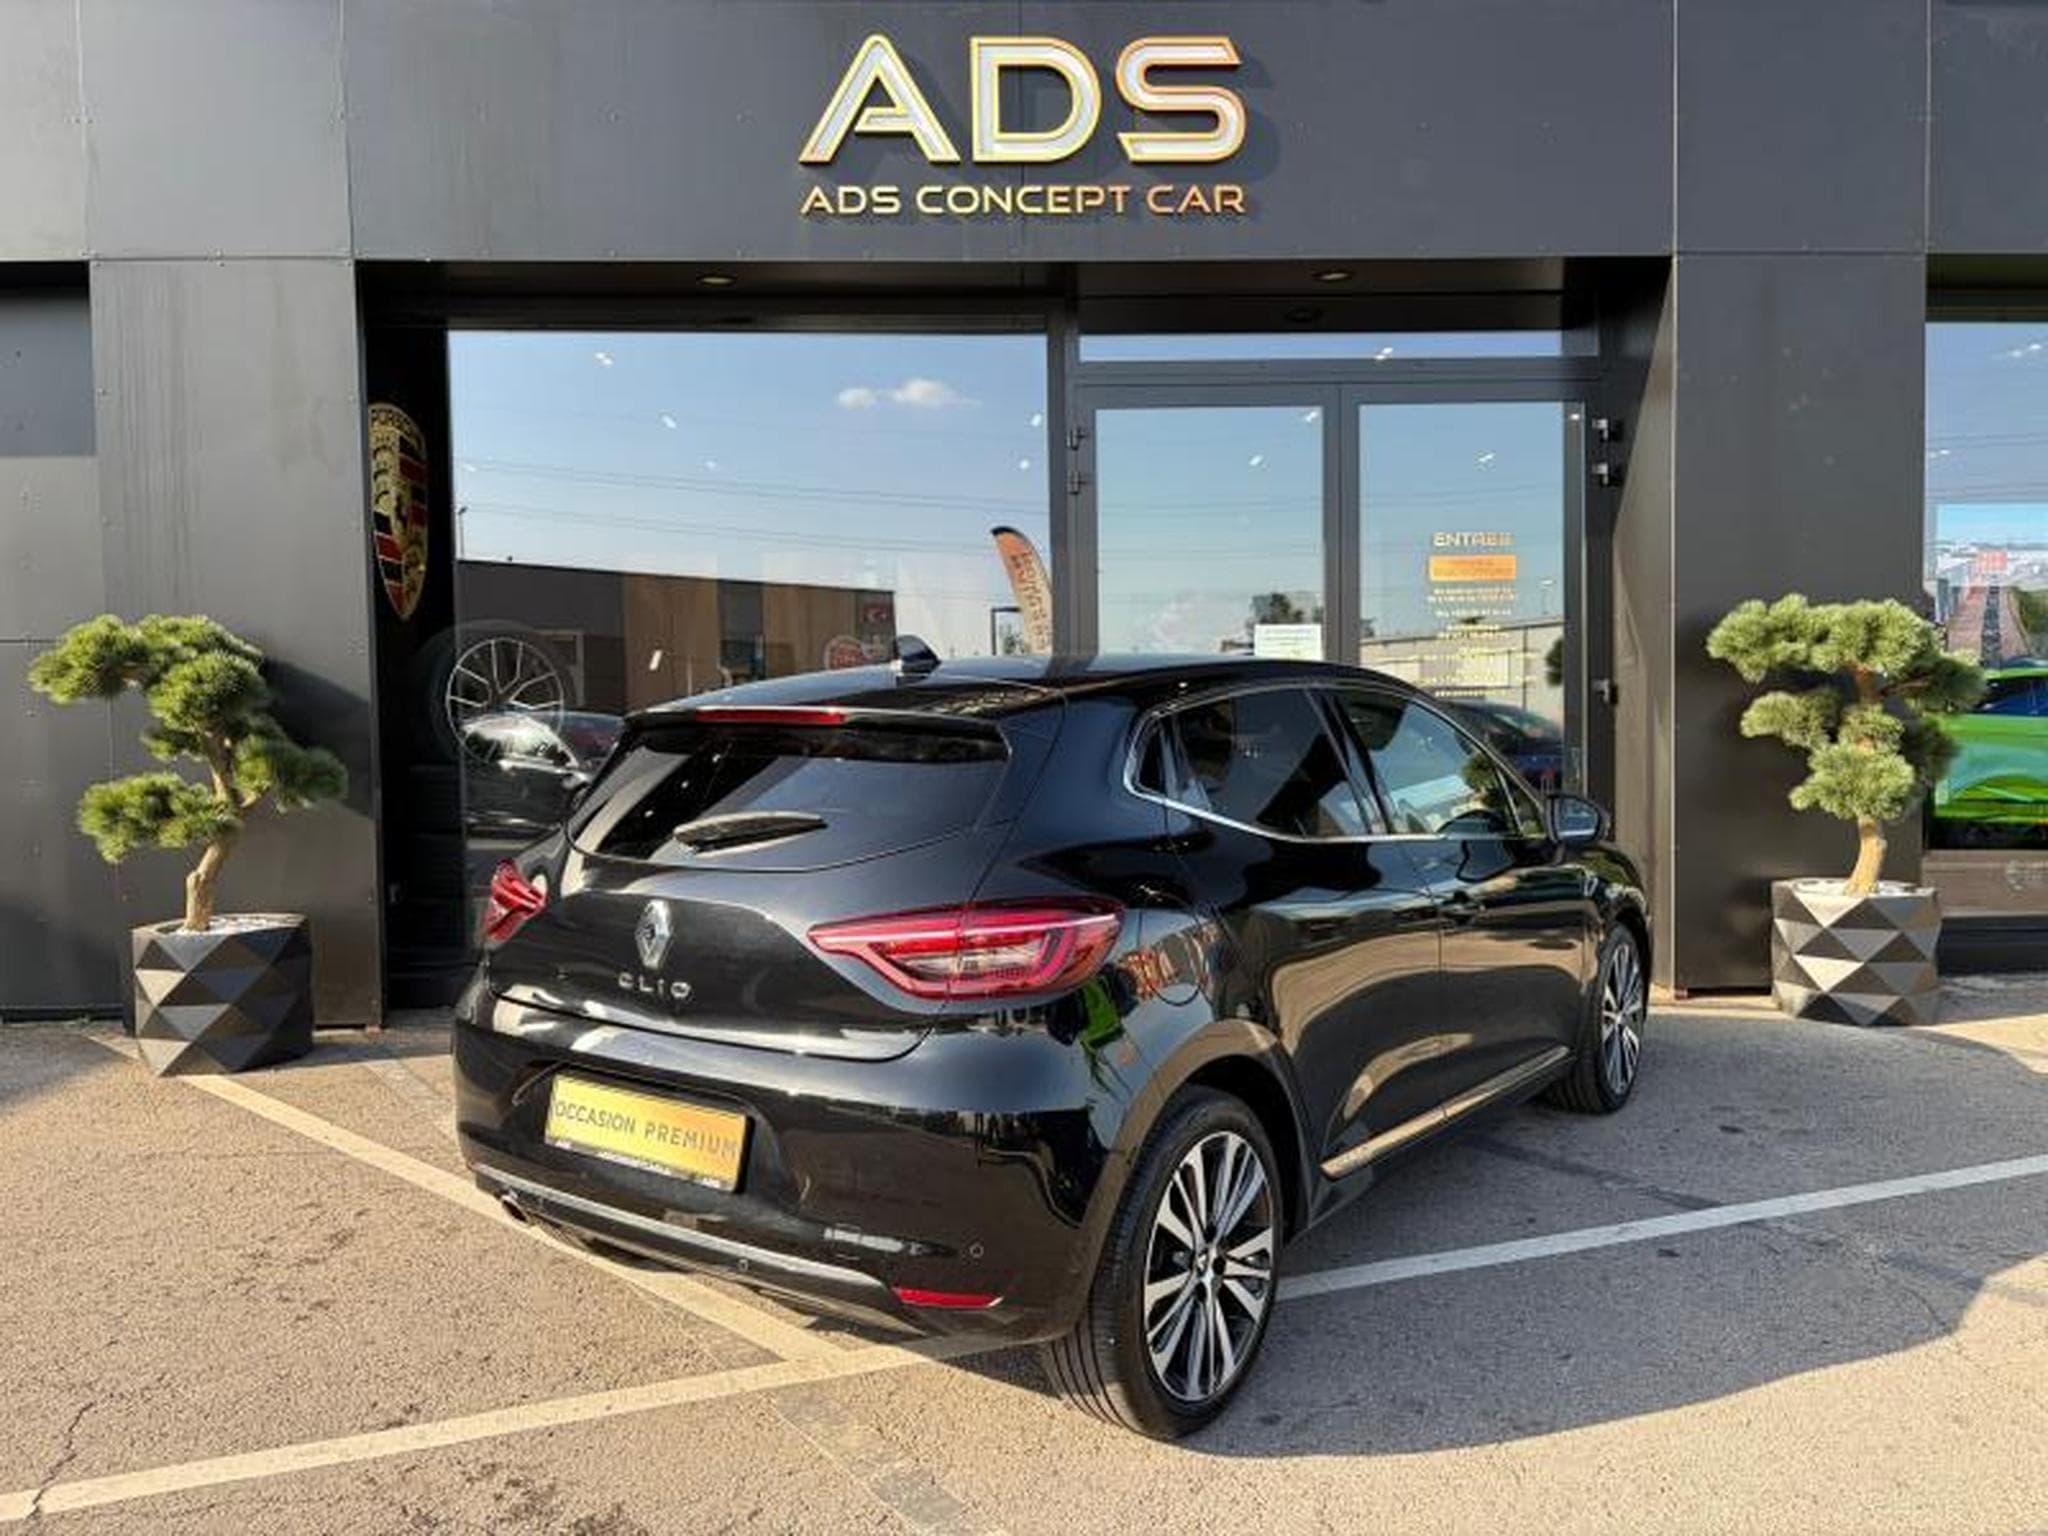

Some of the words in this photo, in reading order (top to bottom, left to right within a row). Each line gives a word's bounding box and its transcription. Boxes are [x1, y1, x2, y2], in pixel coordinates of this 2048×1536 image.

[799, 34, 1246, 163] ADS
[799, 184, 900, 215] ADS
[915, 184, 1132, 215] CONCEPT
[1146, 184, 1246, 215] CAR
[618, 971, 693, 999] CLIO
[554, 1101, 637, 1135] OCCASION
[644, 1121, 738, 1159] PREMIUM
